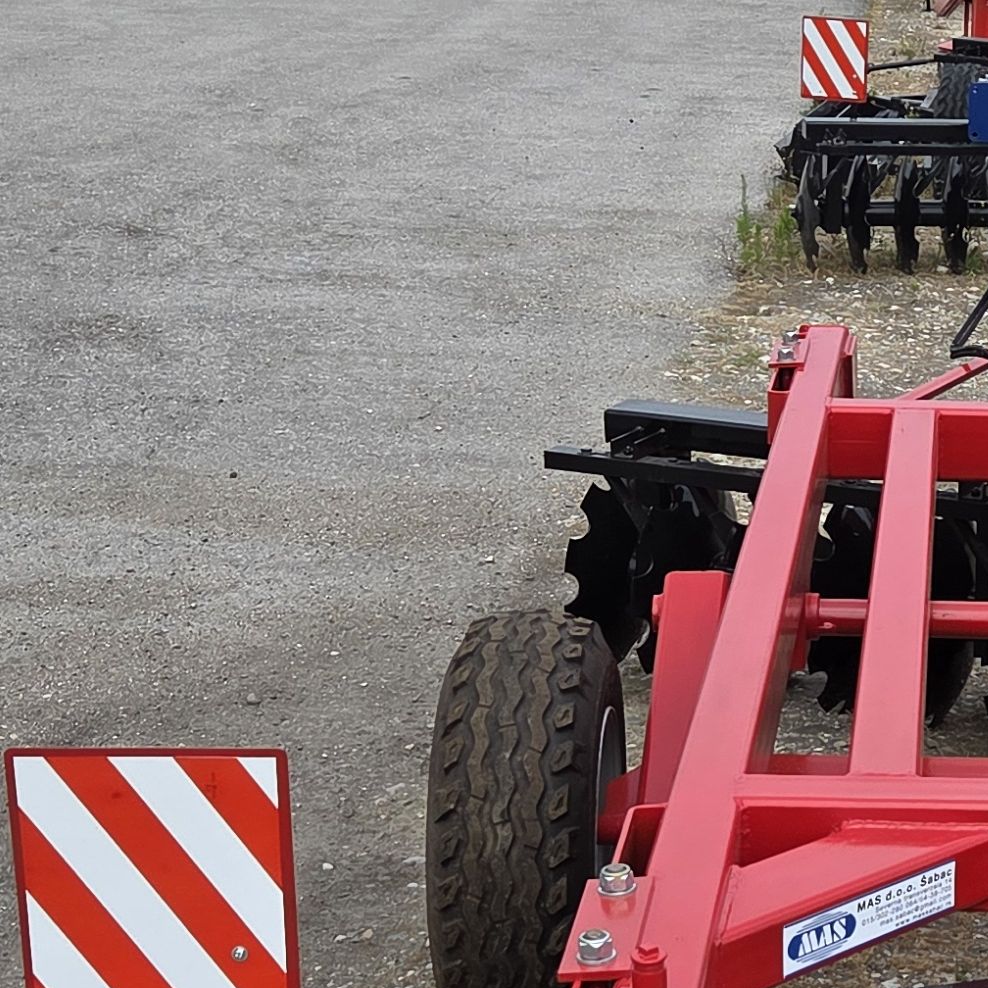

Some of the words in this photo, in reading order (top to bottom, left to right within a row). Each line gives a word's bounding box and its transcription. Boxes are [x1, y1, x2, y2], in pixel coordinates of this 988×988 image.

[857, 895, 882, 913] MAS
[885, 884, 917, 901] d.o.o.
[920, 868, 953, 887] Šabac
[798, 917, 847, 957] MAS
